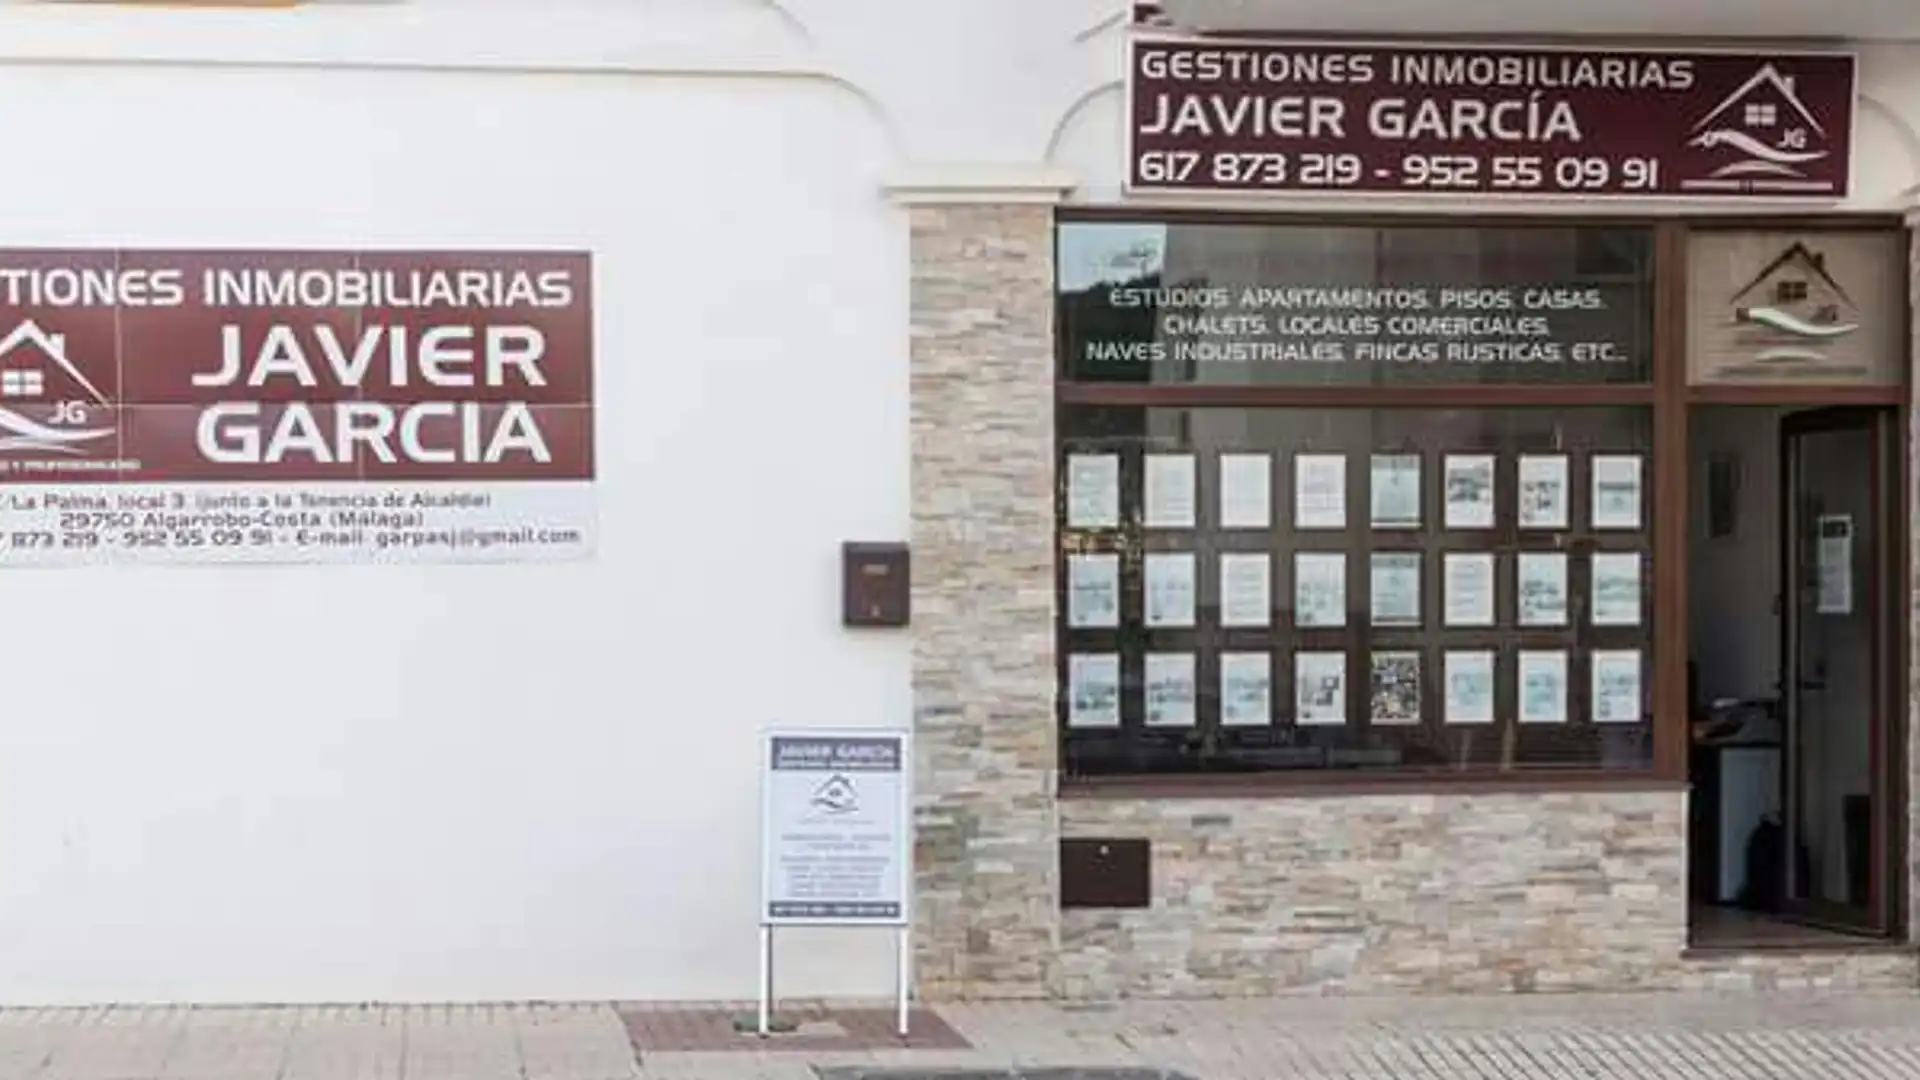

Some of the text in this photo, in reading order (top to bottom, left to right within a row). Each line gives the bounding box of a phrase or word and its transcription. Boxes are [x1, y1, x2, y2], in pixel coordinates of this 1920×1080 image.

[1140, 50, 1696, 90] GESTIONES INMOBILIARIAS
[1139, 88, 1583, 142] JAVIER GARCÍA
[1138, 151, 1201, 182] 617
[1211, 153, 1287, 183] 873
[1300, 154, 1363, 185] 219
[1402, 154, 1480, 186] 952
[1492, 157, 1543, 187] 55
[1555, 157, 1609, 188] 09
[1621, 158, 1659, 189] 91
[204, 269, 572, 308] INMOBILIARIAS
[1278, 315, 1379, 335] LOCALES
[191, 324, 548, 387] JAVIER
[1085, 341, 1166, 361] NAVES
[1355, 342, 1439, 361] FINCAS
[47, 400, 88, 424] JG
[199, 402, 553, 464] GARCIA
[59, 512, 135, 529] 29750
[143, 511, 321, 531] Algarrobo-Costa
[123, 531, 168, 547] 952
[175, 531, 203, 546] 55
[210, 530, 243, 546] 09
